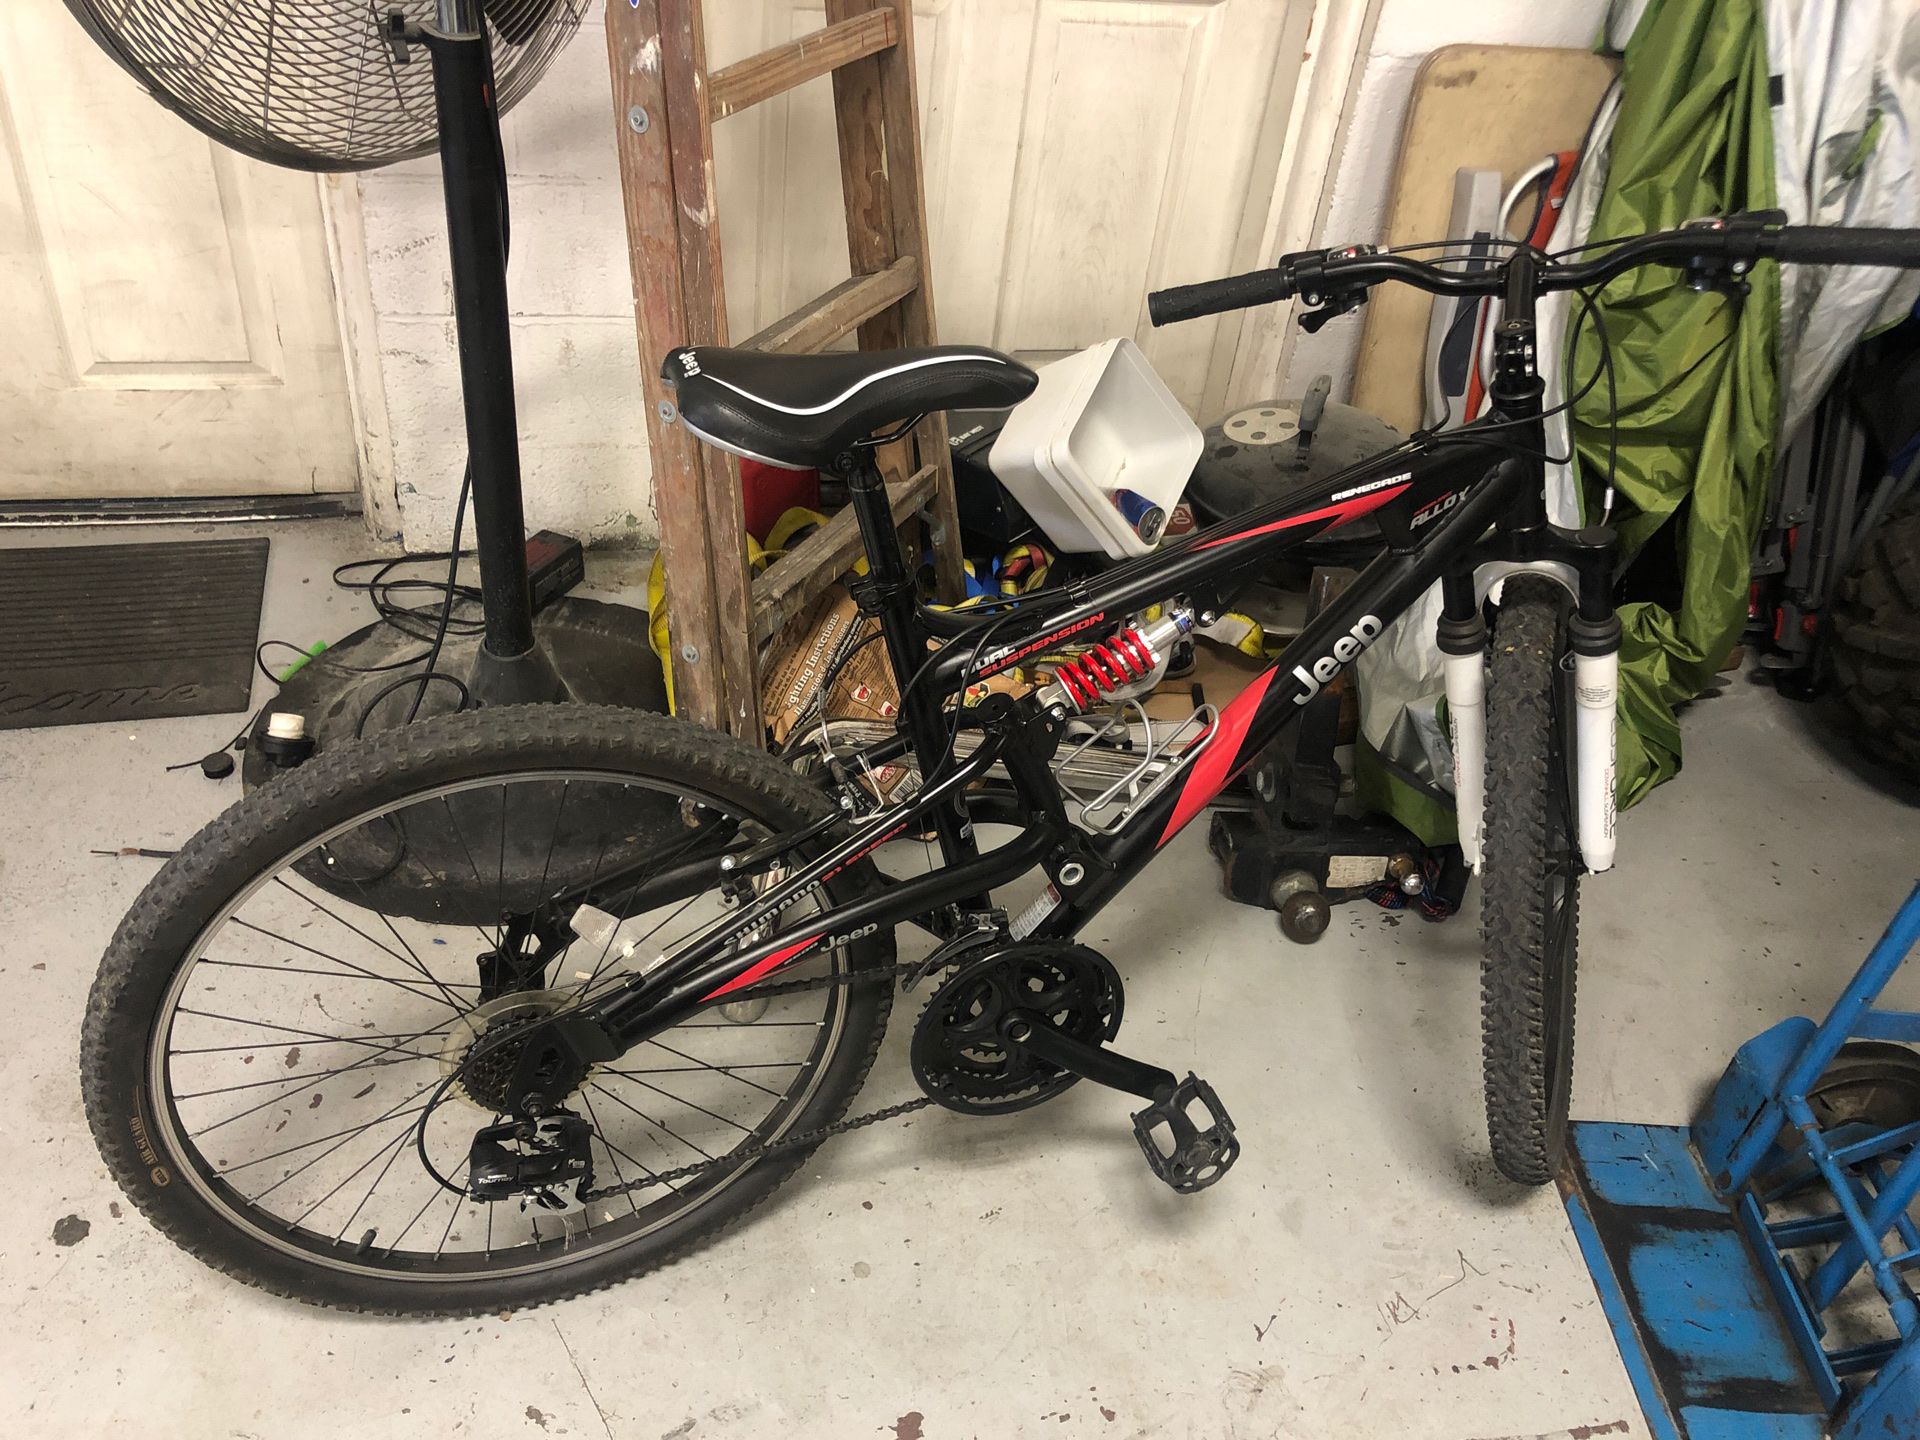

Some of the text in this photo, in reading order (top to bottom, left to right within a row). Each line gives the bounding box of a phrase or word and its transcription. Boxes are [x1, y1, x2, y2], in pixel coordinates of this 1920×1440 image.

[679, 351, 701, 377] Jeep
[1331, 472, 1412, 502] RENEGADE
[1409, 485, 1471, 531] ALLOY
[979, 611, 1105, 678] SUSPENSION
[1292, 614, 1383, 706] Jeep
[820, 922, 878, 953] Jeep
